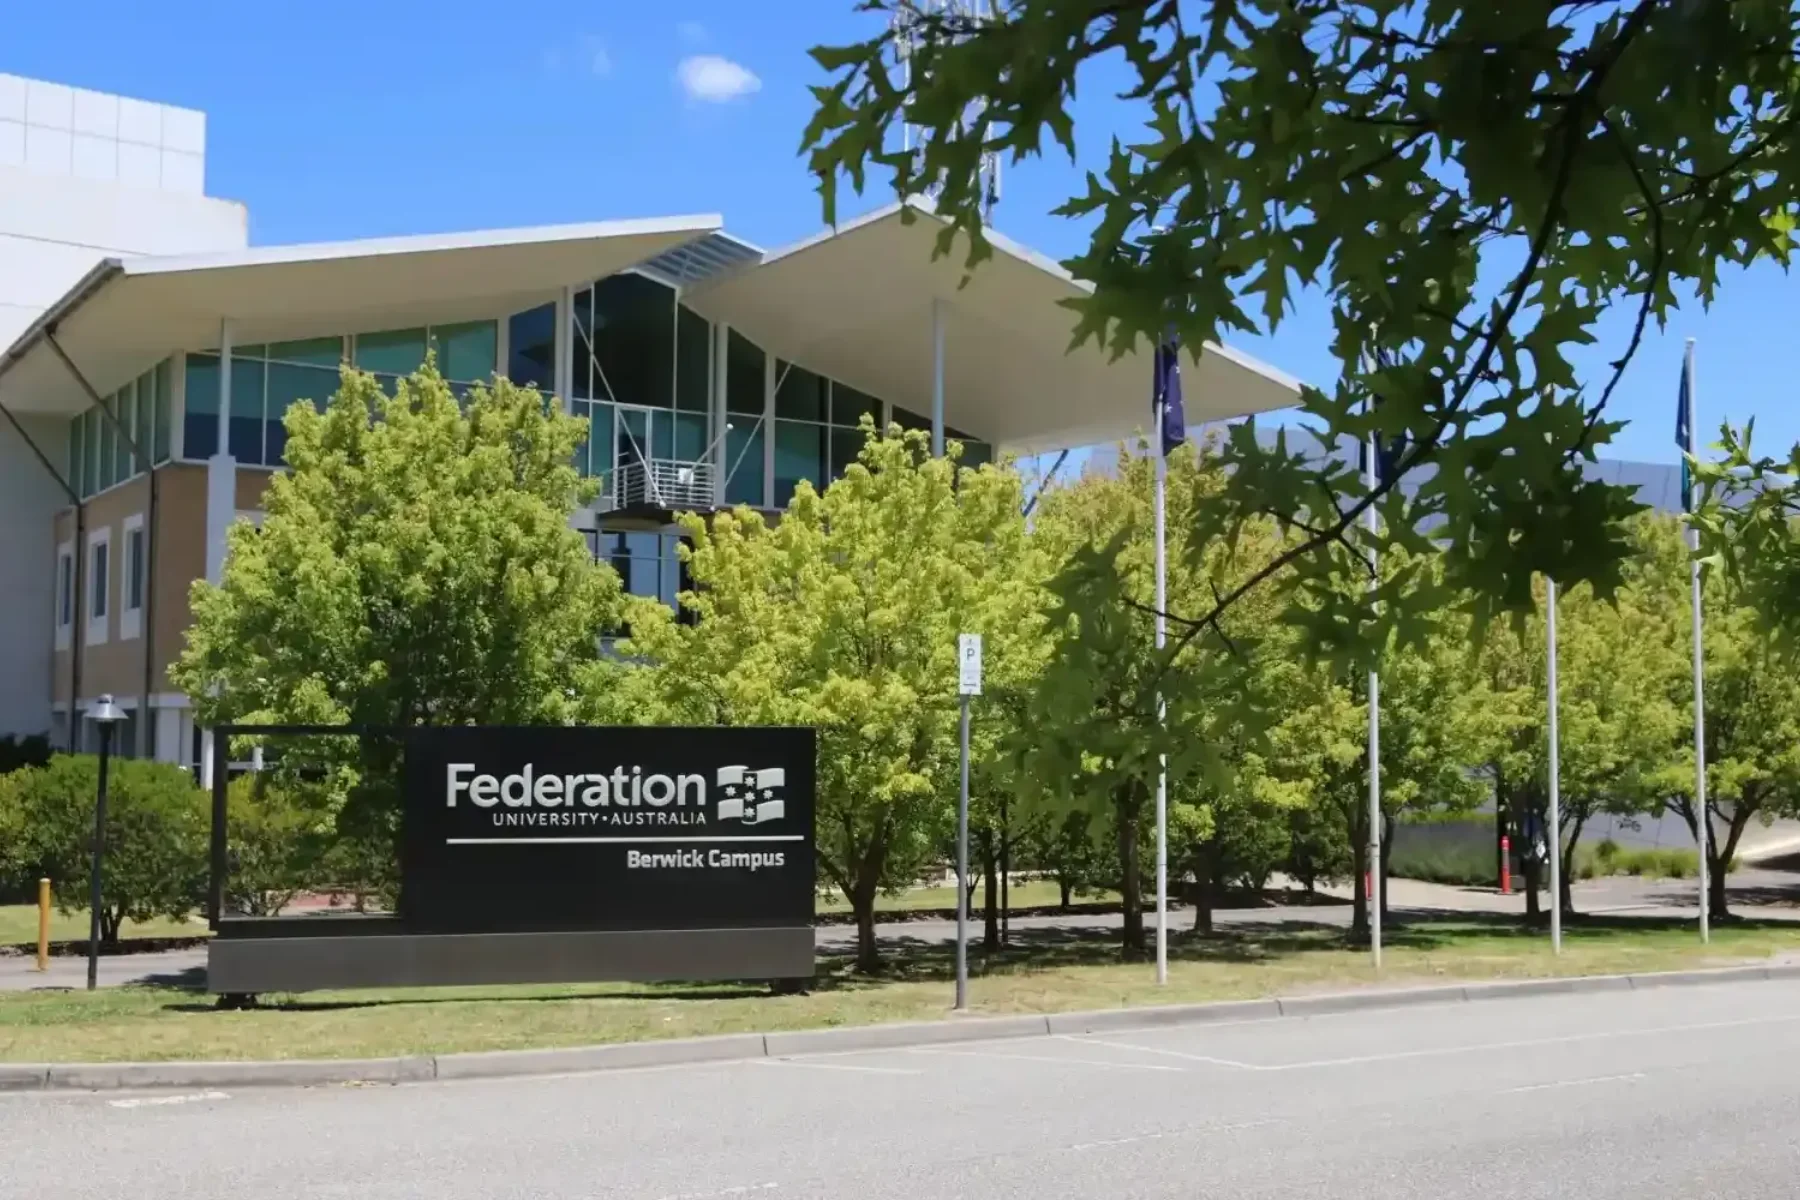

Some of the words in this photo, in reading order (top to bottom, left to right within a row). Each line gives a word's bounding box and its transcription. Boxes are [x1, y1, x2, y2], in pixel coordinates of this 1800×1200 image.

[966, 647, 976, 661] P
[446, 762, 706, 808] Federation
[627, 848, 704, 869] Berwick
[708, 848, 785, 872] Campus
